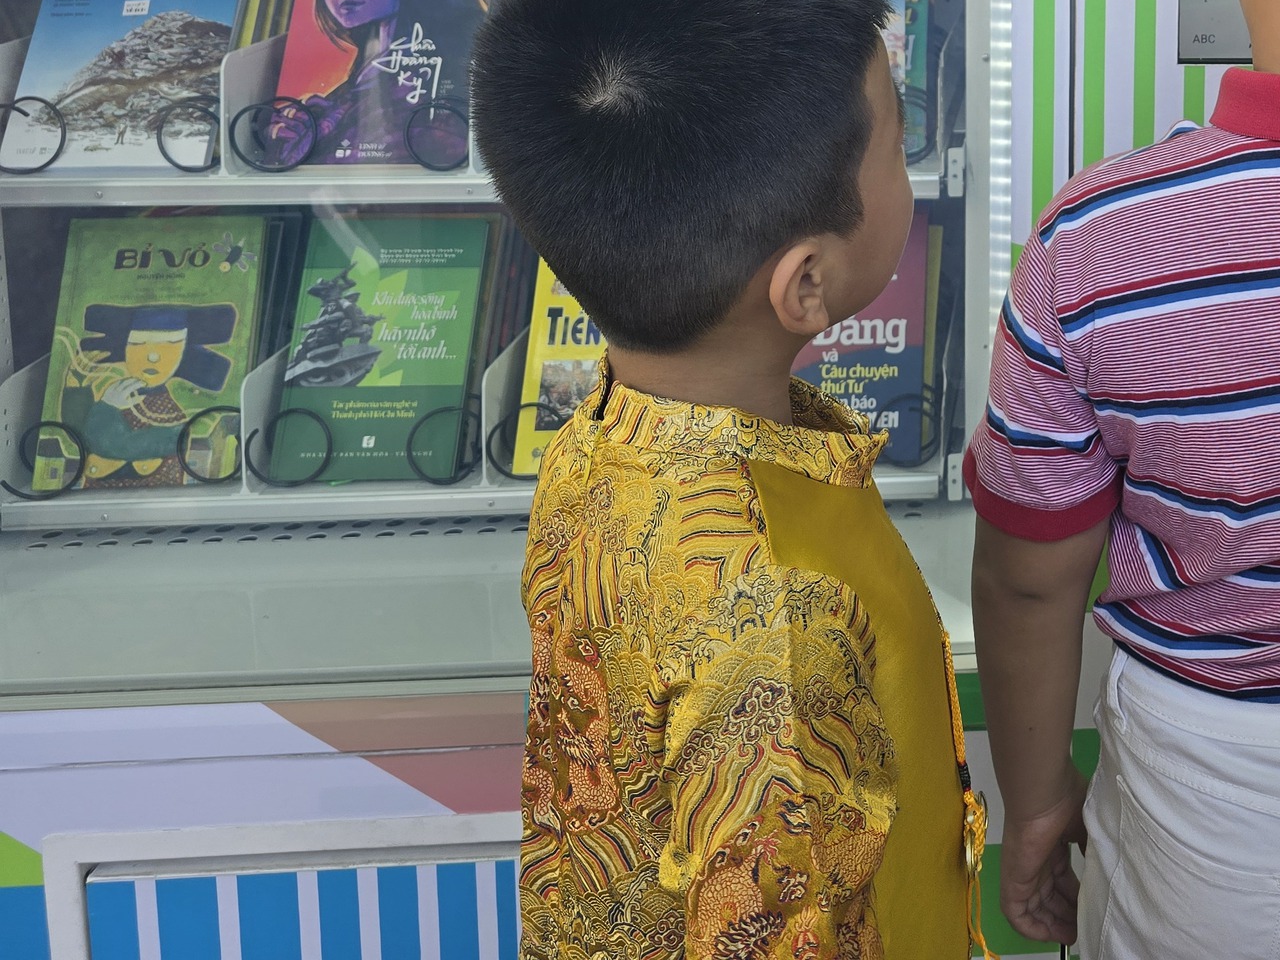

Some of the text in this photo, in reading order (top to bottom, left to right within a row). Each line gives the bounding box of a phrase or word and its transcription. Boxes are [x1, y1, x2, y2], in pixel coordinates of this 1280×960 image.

[1192, 34, 1216, 44] ABC
[822, 348, 839, 363] và
[849, 364, 898, 381] chuyện
[850, 394, 877, 409] báo
